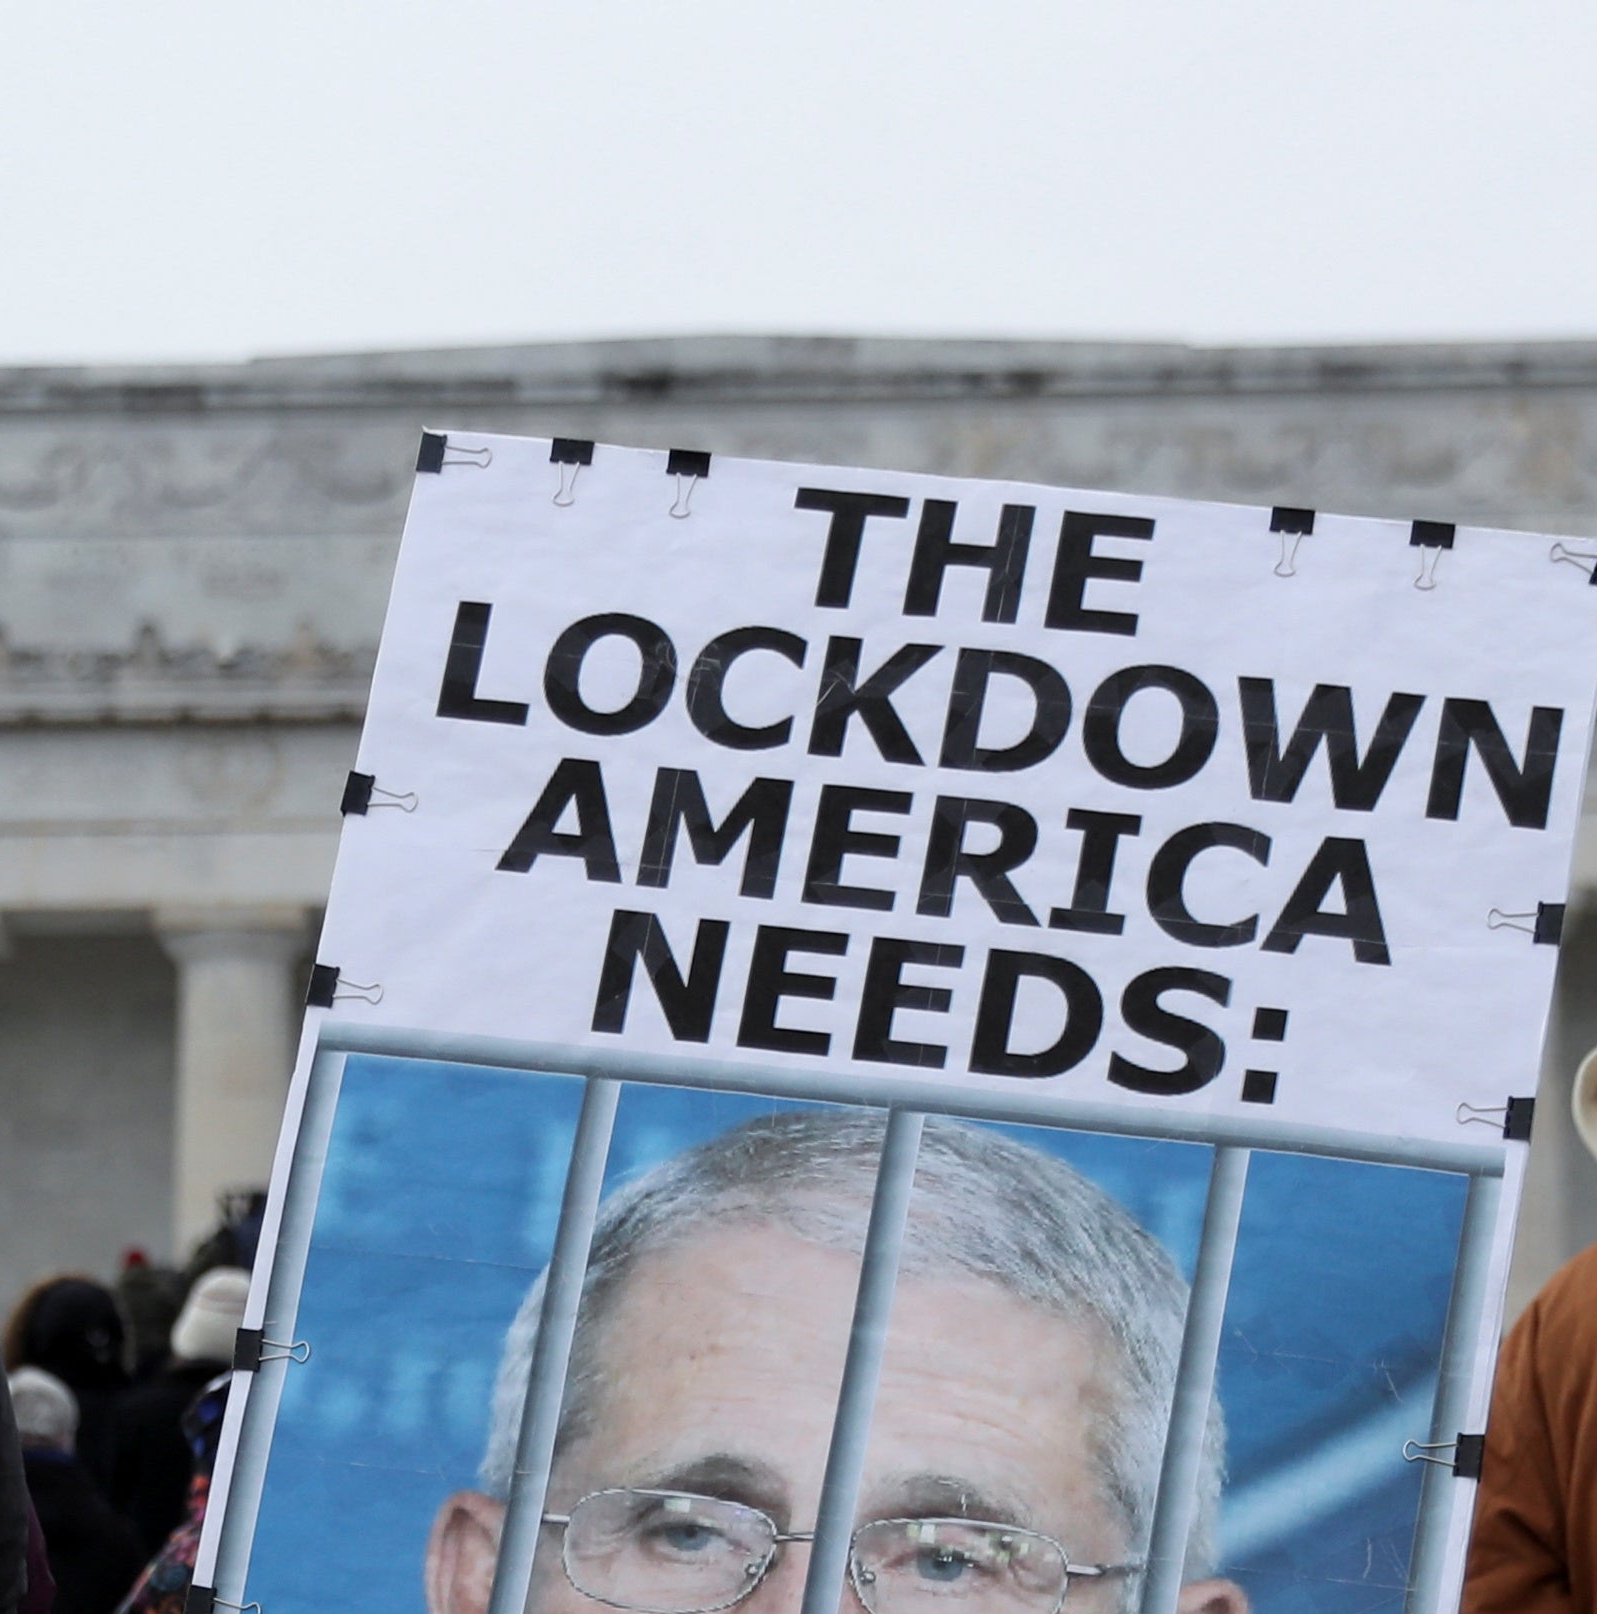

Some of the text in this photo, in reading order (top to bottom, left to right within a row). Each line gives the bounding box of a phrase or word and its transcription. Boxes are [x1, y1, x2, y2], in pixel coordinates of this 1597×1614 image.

[795, 487, 1155, 635] THE
[436, 600, 1564, 829] LOCKDOWN
[497, 757, 1390, 965] AMERICA
[591, 909, 1288, 1104] NEEDS:
